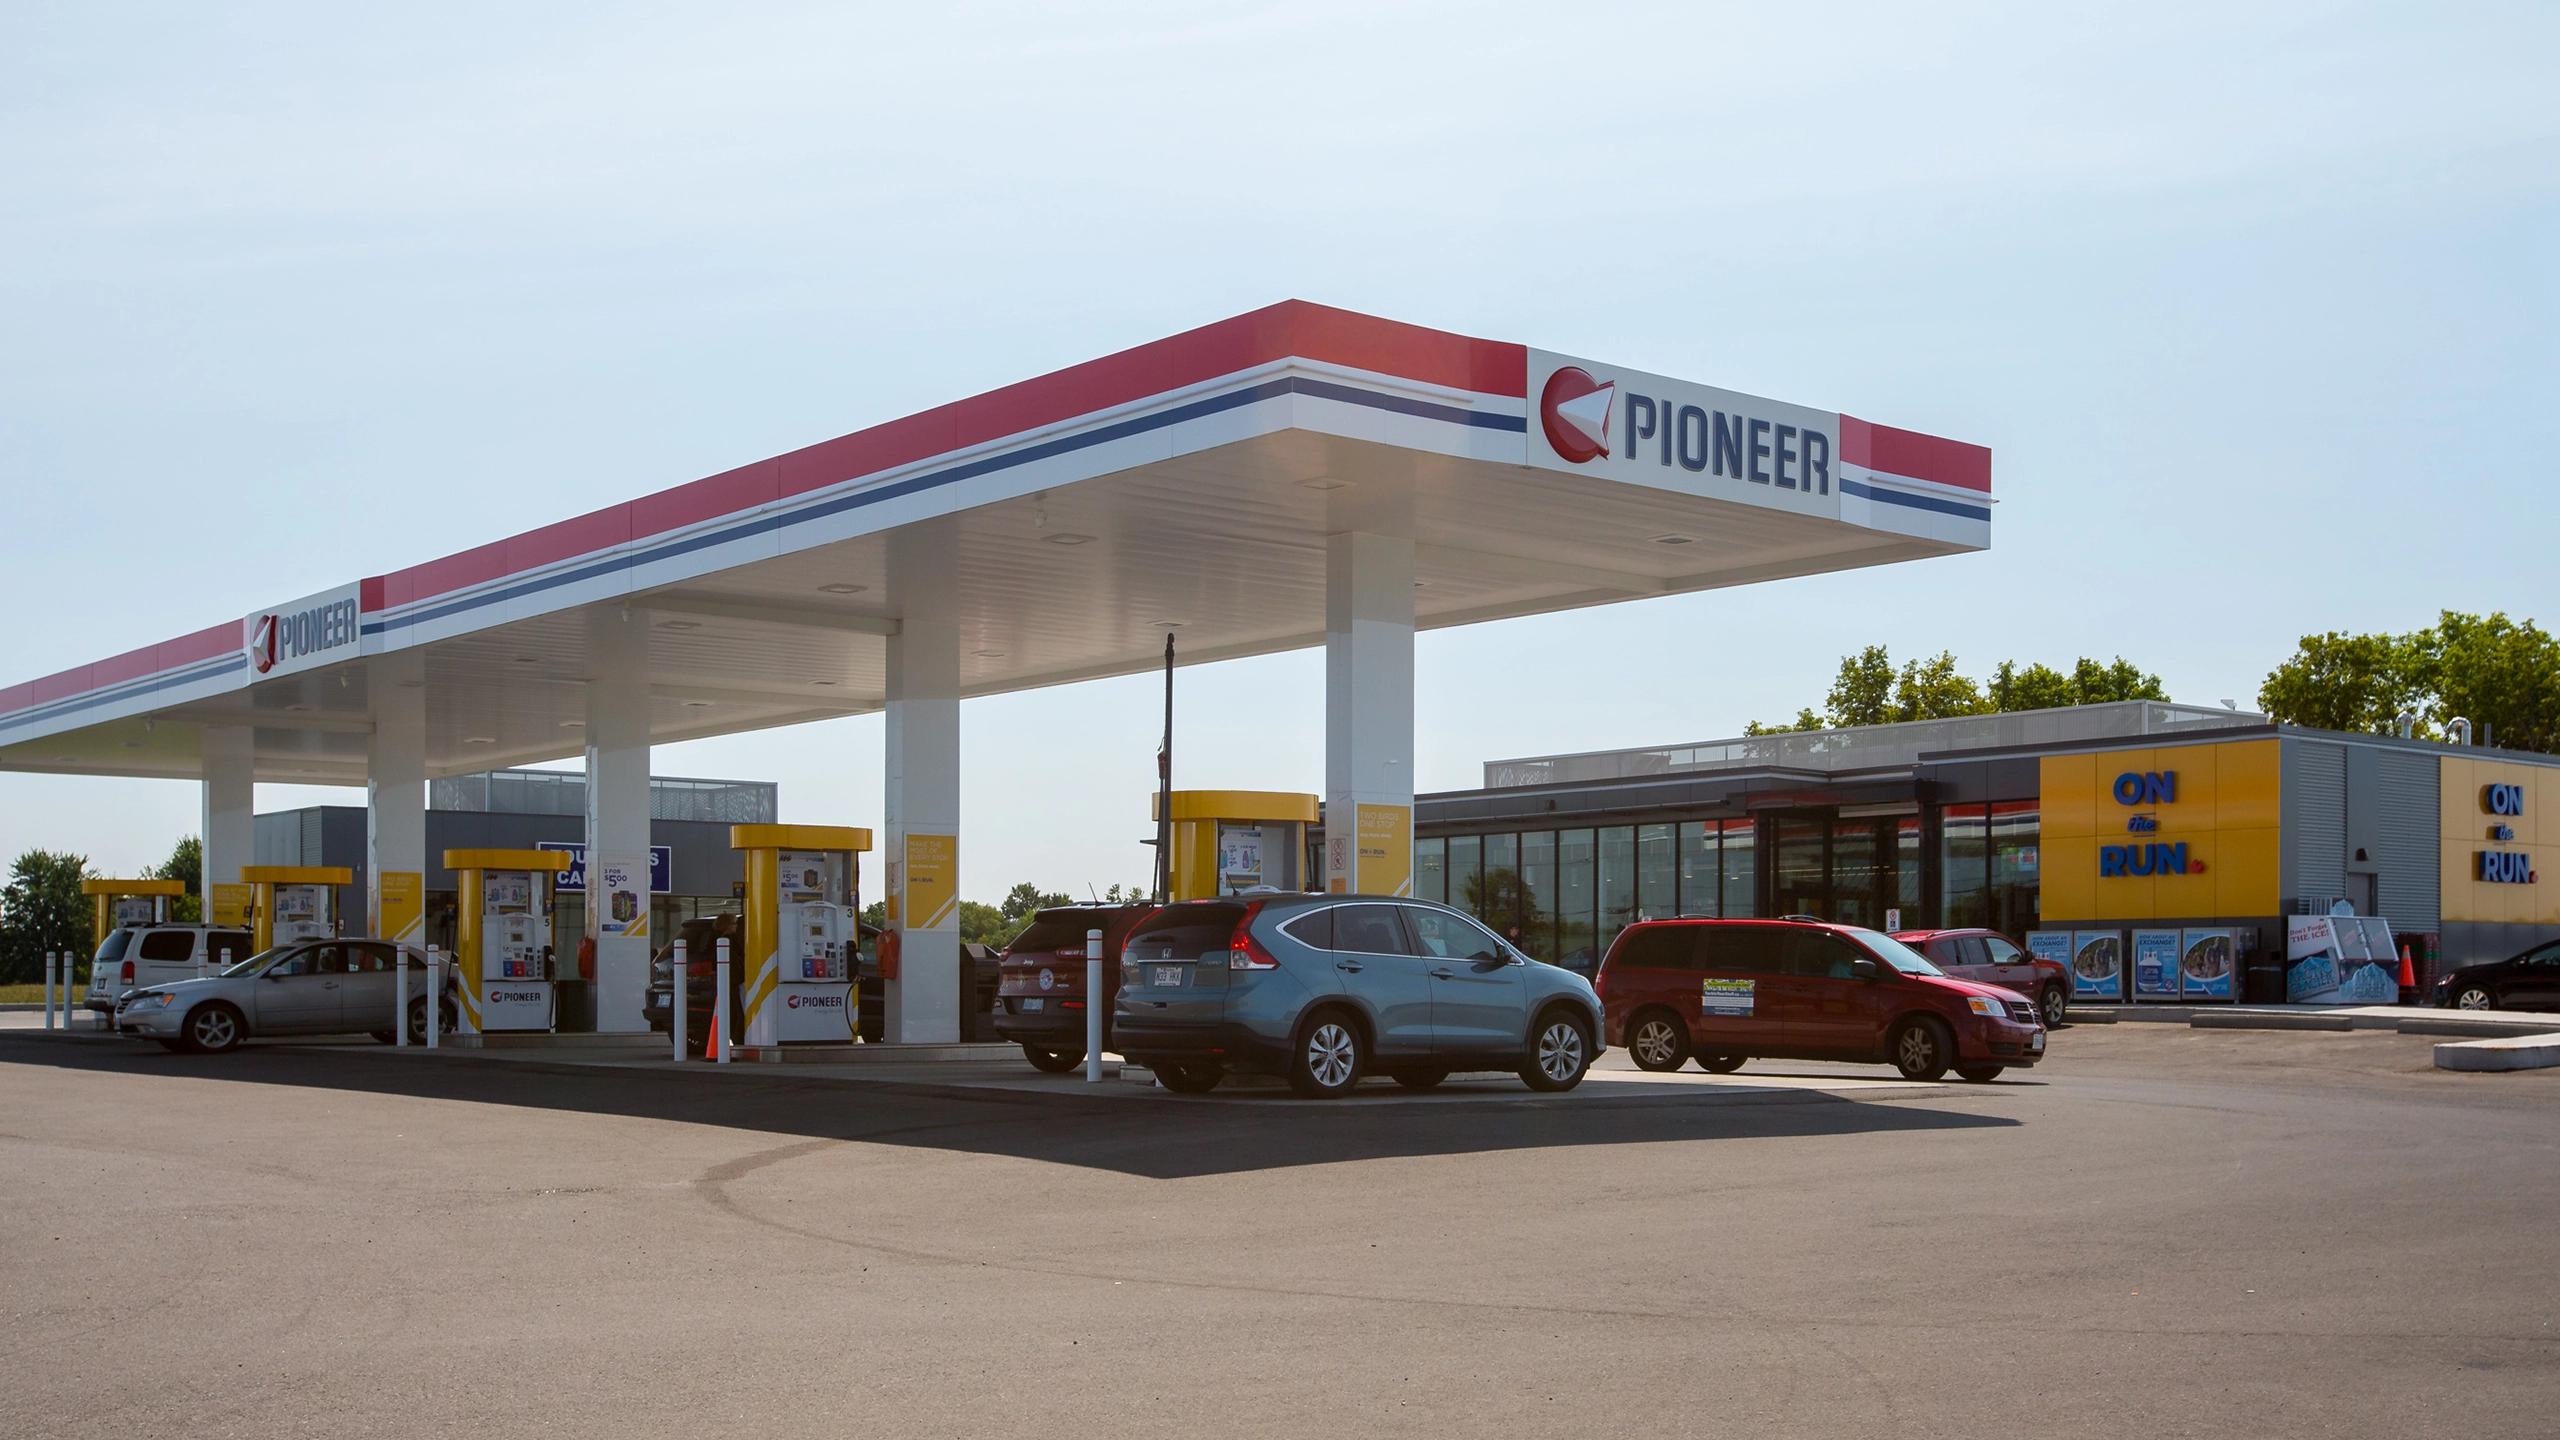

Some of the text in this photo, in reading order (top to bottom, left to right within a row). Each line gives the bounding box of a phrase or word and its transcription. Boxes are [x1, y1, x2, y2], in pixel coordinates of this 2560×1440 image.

[1625, 391, 1830, 497] PIONEER
[280, 598, 357, 661] PIONEER
[2113, 770, 2176, 806] ON
[2488, 783, 2523, 816] ON
[2128, 815, 2157, 832] the
[2496, 825, 2514, 841] the
[2100, 842, 2188, 878] RUN
[2480, 851, 2531, 884] RUN
[847, 908, 853, 918] 3
[328, 925, 334, 933] 7
[544, 918, 550, 927] 5
[2290, 934, 2310, 943] THE
[504, 992, 541, 1002] PIONEER
[802, 996, 843, 1008] PIONEER
